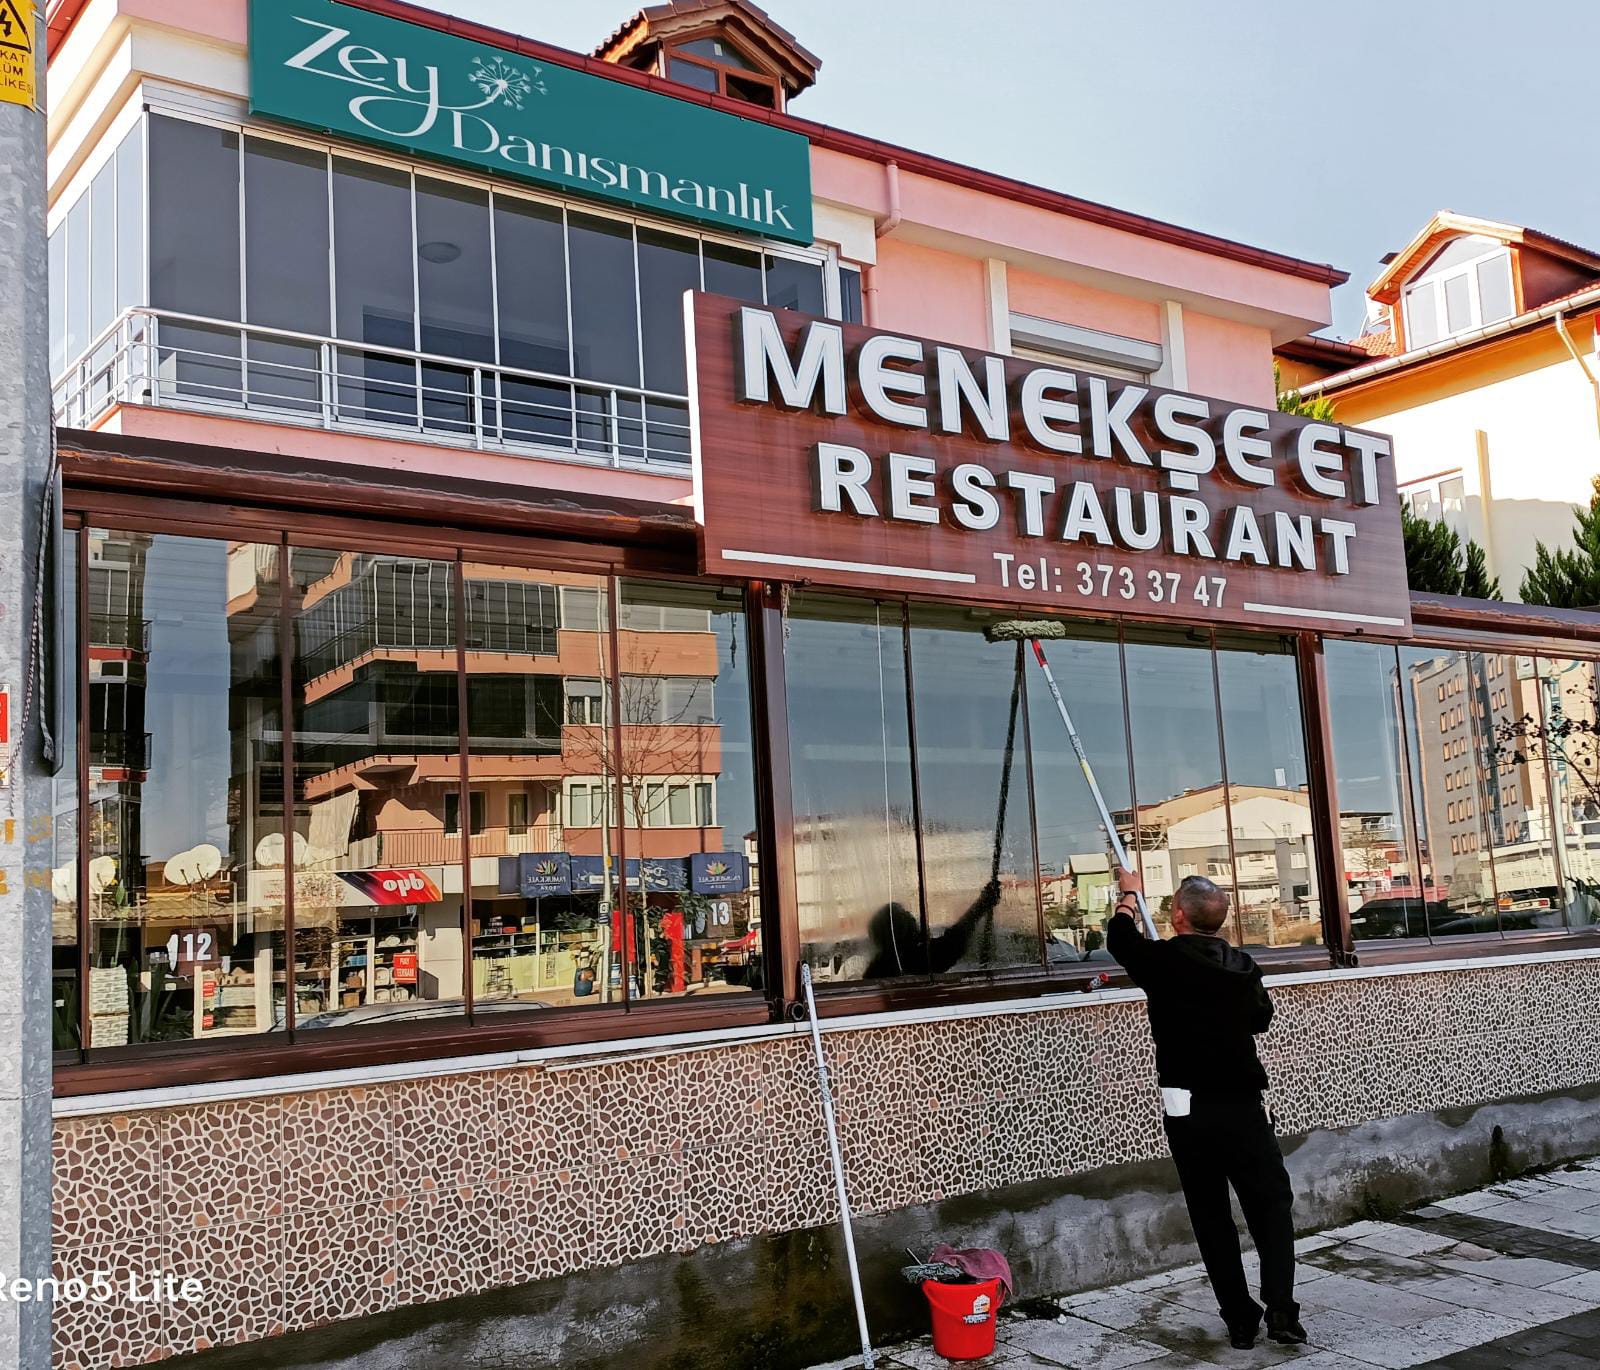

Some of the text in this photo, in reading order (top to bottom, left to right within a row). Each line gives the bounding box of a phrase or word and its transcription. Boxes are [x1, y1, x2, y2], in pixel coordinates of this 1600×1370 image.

[0, 61, 24, 77] ÜM
[283, 15, 446, 137] Zey
[452, 109, 796, 231] Danışmanlık
[738, 306, 1392, 506] MENEKŞE ET
[817, 441, 1358, 576] RESTAURANT
[993, 551, 1228, 609] Tel: 373 37 47
[710, 901, 730, 926] 13
